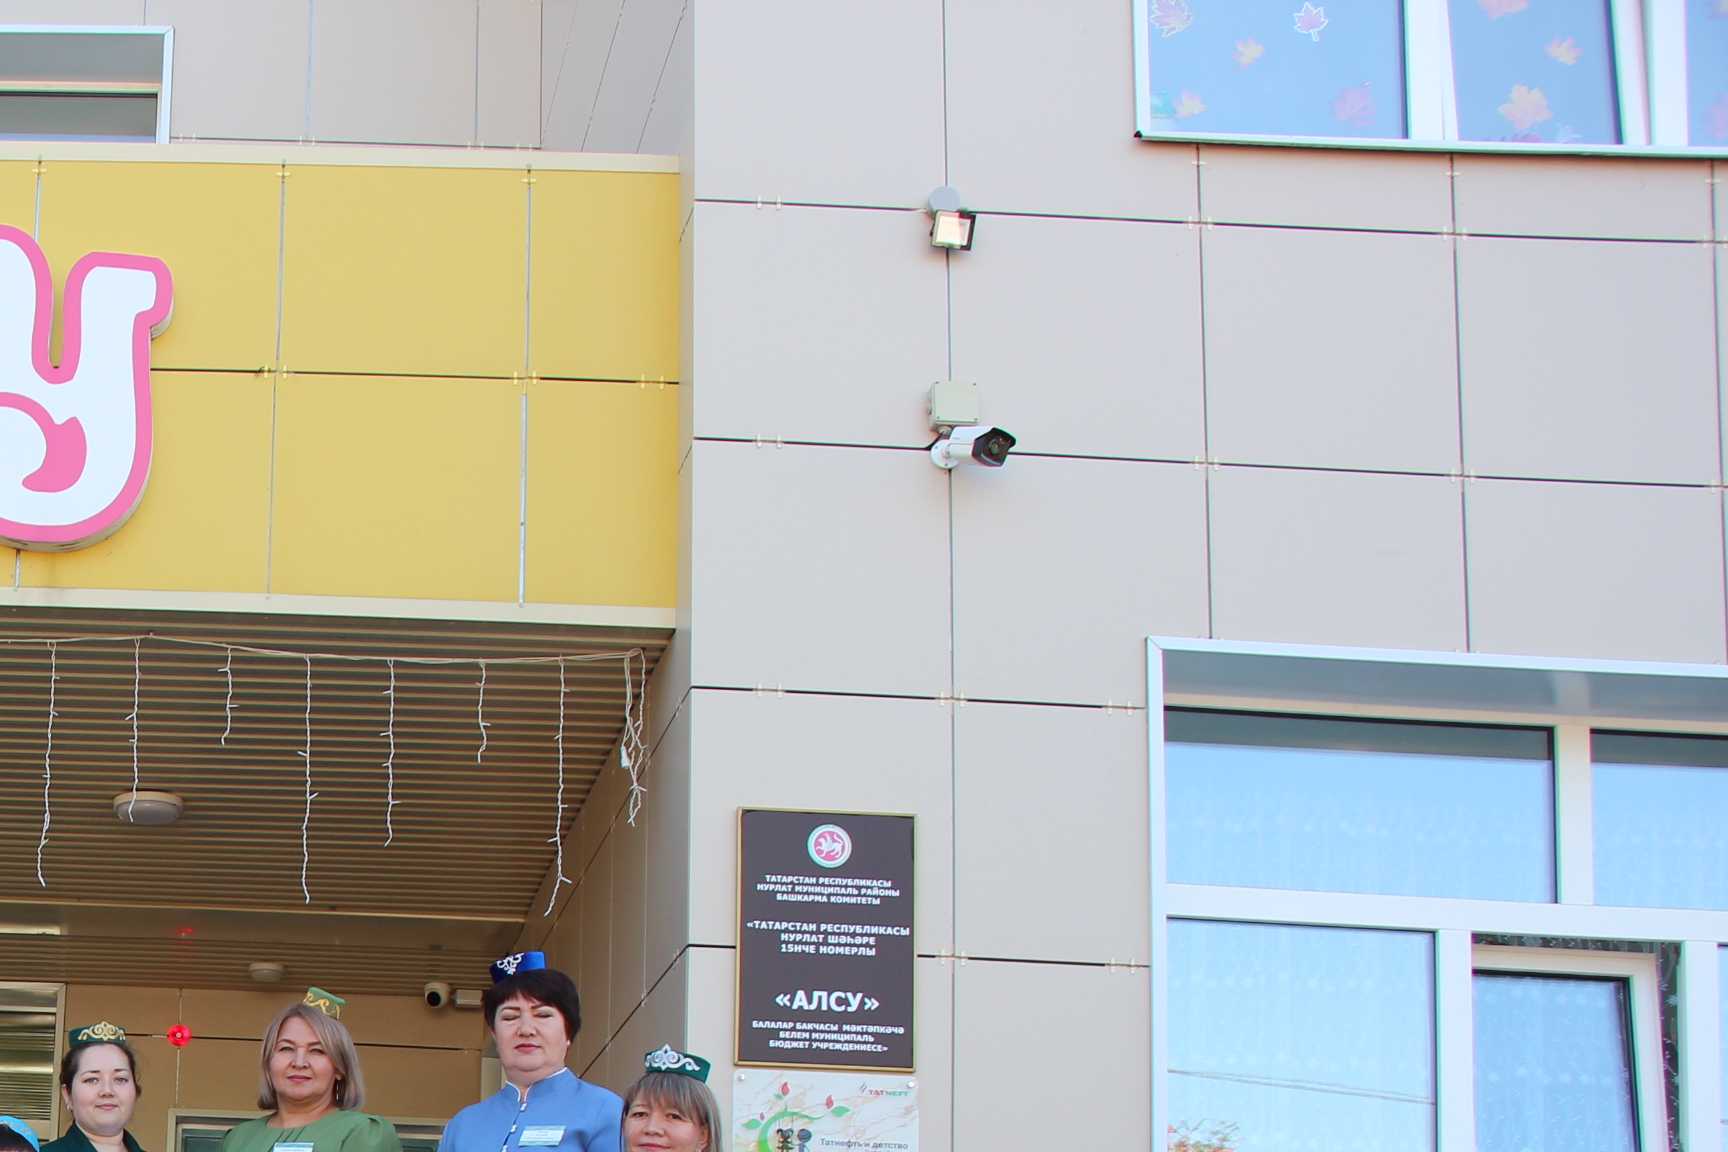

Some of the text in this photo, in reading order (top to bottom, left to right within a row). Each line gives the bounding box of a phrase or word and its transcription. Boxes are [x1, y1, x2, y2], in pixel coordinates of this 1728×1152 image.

[765, 875, 892, 887] ТАТАРСТАН РЕСПУБЛИКАСЫ
[757, 884, 900, 897] НУРЛАТ МУНИЦИПАЛЬ РАЙОНЫ
[776, 894, 880, 905] БАШКАРМА КОМИТЕТЫ
[747, 921, 910, 936] «ТАТАРСТАН РЕСПУБЛИКАСЫ
[781, 934, 825, 944] НУРЛАТ
[781, 944, 876, 956] 15НЧЕ НОМЕРЛЫ
[775, 990, 880, 1012] «АЛСУ»
[752, 1021, 794, 1030] БАЛАЛАР
[796, 1022, 839, 1032] БАКЧАСЫ
[779, 1031, 875, 1042] БЕЛЕМ МУНИЦИПАЛЬ
[769, 1040, 888, 1052] БЮДЖЕТ УЧРЕЖДЕНИЕСЕ»
[820, 1138, 863, 1148] Татнефть
[872, 1141, 908, 1149] детство
